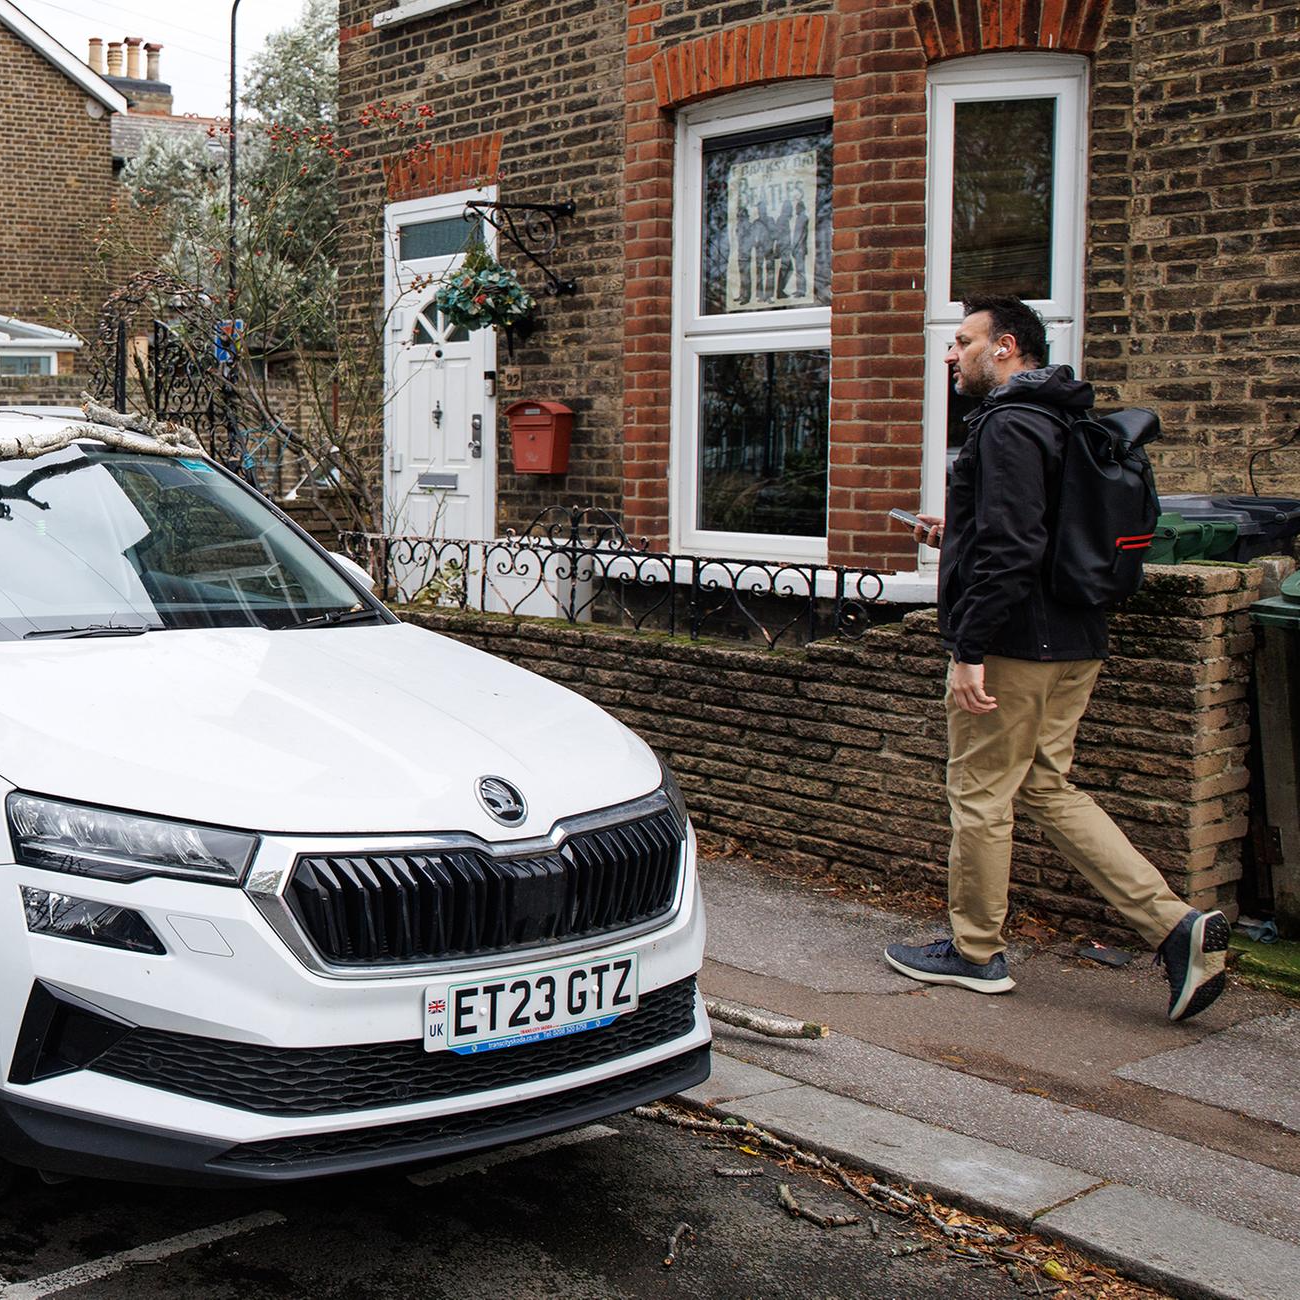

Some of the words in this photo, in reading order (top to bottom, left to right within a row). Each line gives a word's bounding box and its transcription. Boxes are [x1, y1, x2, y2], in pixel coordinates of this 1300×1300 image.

[738, 178, 805, 211] BEATLES
[506, 374, 520, 386] 92
[454, 976, 556, 1037] ET23
[567, 959, 632, 1016] GTZ
[429, 1023, 444, 1037] UK
